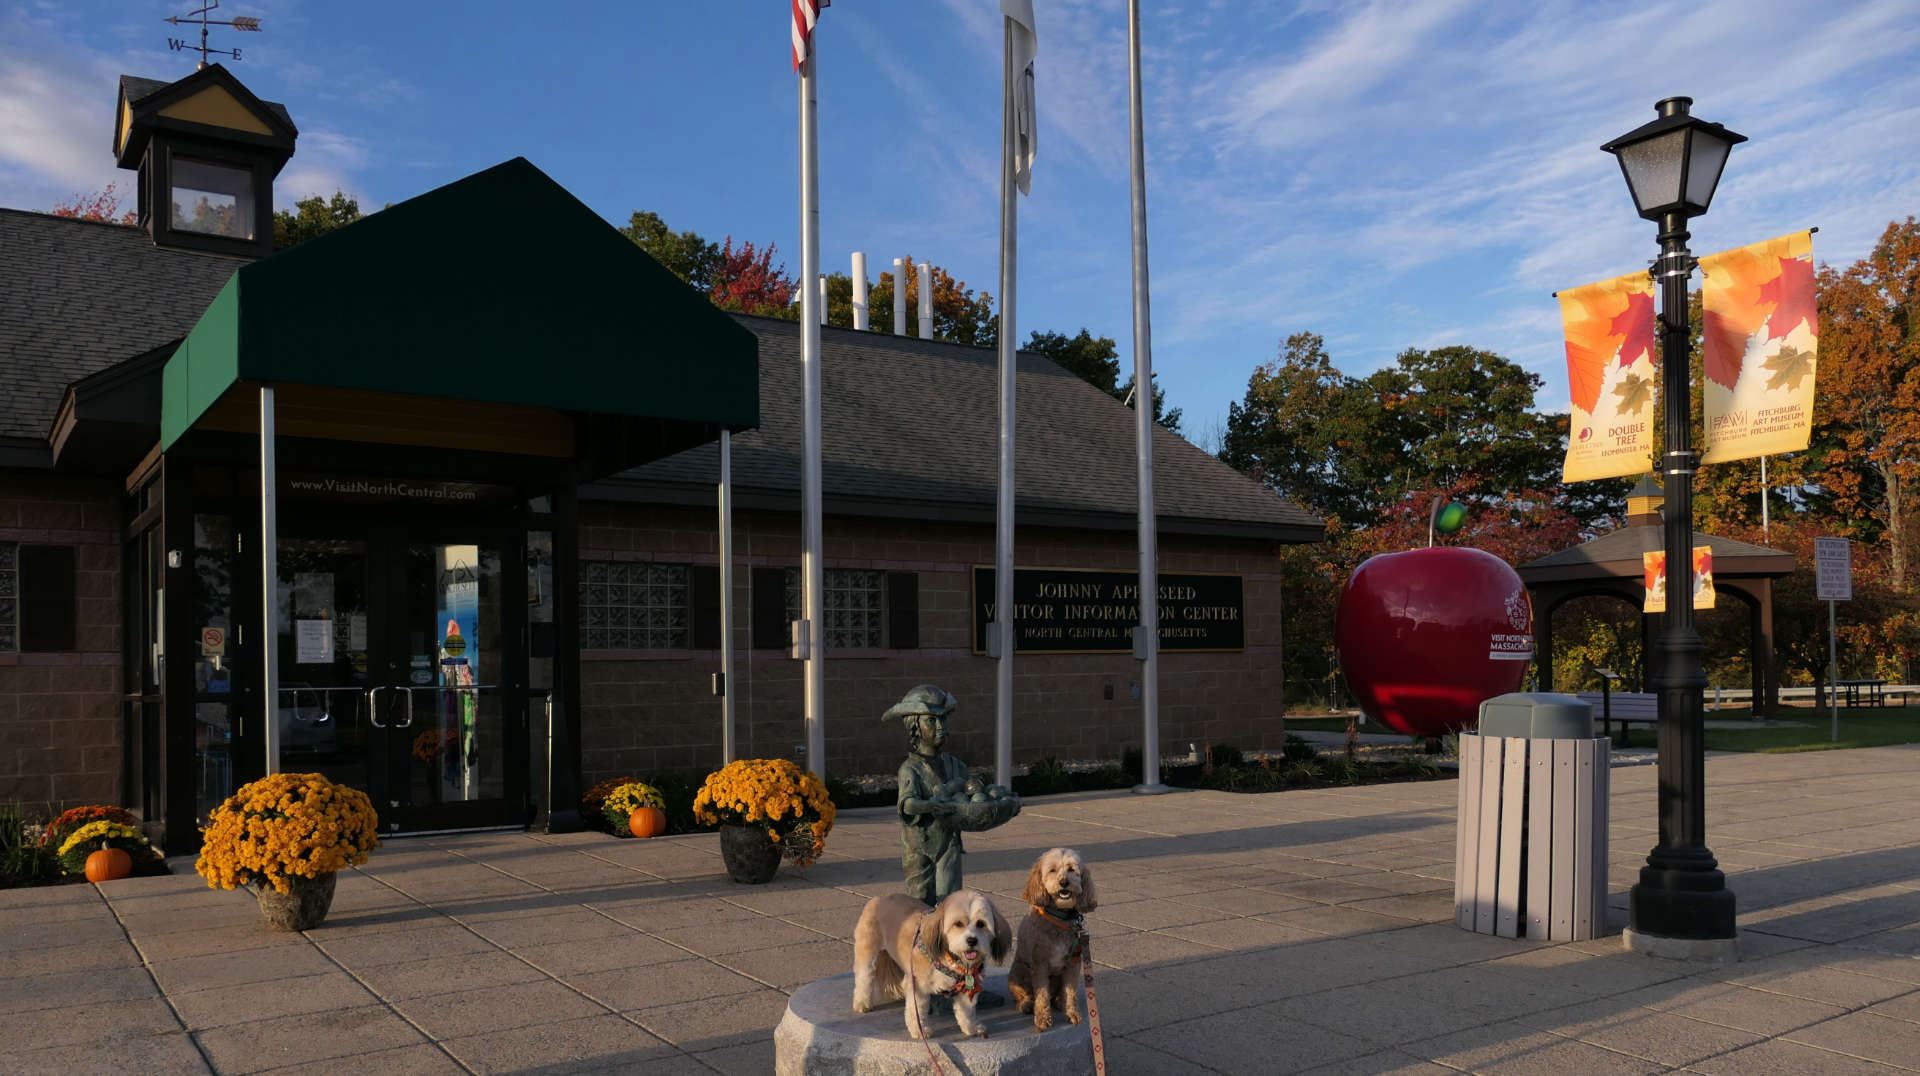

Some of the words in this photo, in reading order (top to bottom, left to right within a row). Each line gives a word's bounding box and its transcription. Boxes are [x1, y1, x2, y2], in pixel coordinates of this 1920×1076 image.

[168, 37, 186, 52] W
[232, 47, 242, 61] E
[1757, 403, 1801, 417] FITCHBURG
[1752, 417, 1769, 426] ART
[1770, 411, 1804, 424] MUSEUM
[1793, 420, 1805, 429] MA
[1608, 422, 1645, 438] DOUBLE
[1616, 434, 1637, 446] TREE
[290, 479, 476, 500] www.VisitNorthCentral.com
[1035, 583, 1102, 598] JOHNNY
[1112, 584, 1197, 601] APPSEED
[984, 603, 1054, 619] VITOR
[1064, 604, 1175, 620] INFORMAN
[1183, 606, 1239, 621] CENTER
[1024, 627, 1062, 639] NORTH
[1068, 627, 1118, 638] CENTRAL
[1124, 627, 1208, 638] MCHUSETTS
[1491, 633, 1505, 642] VISIT
